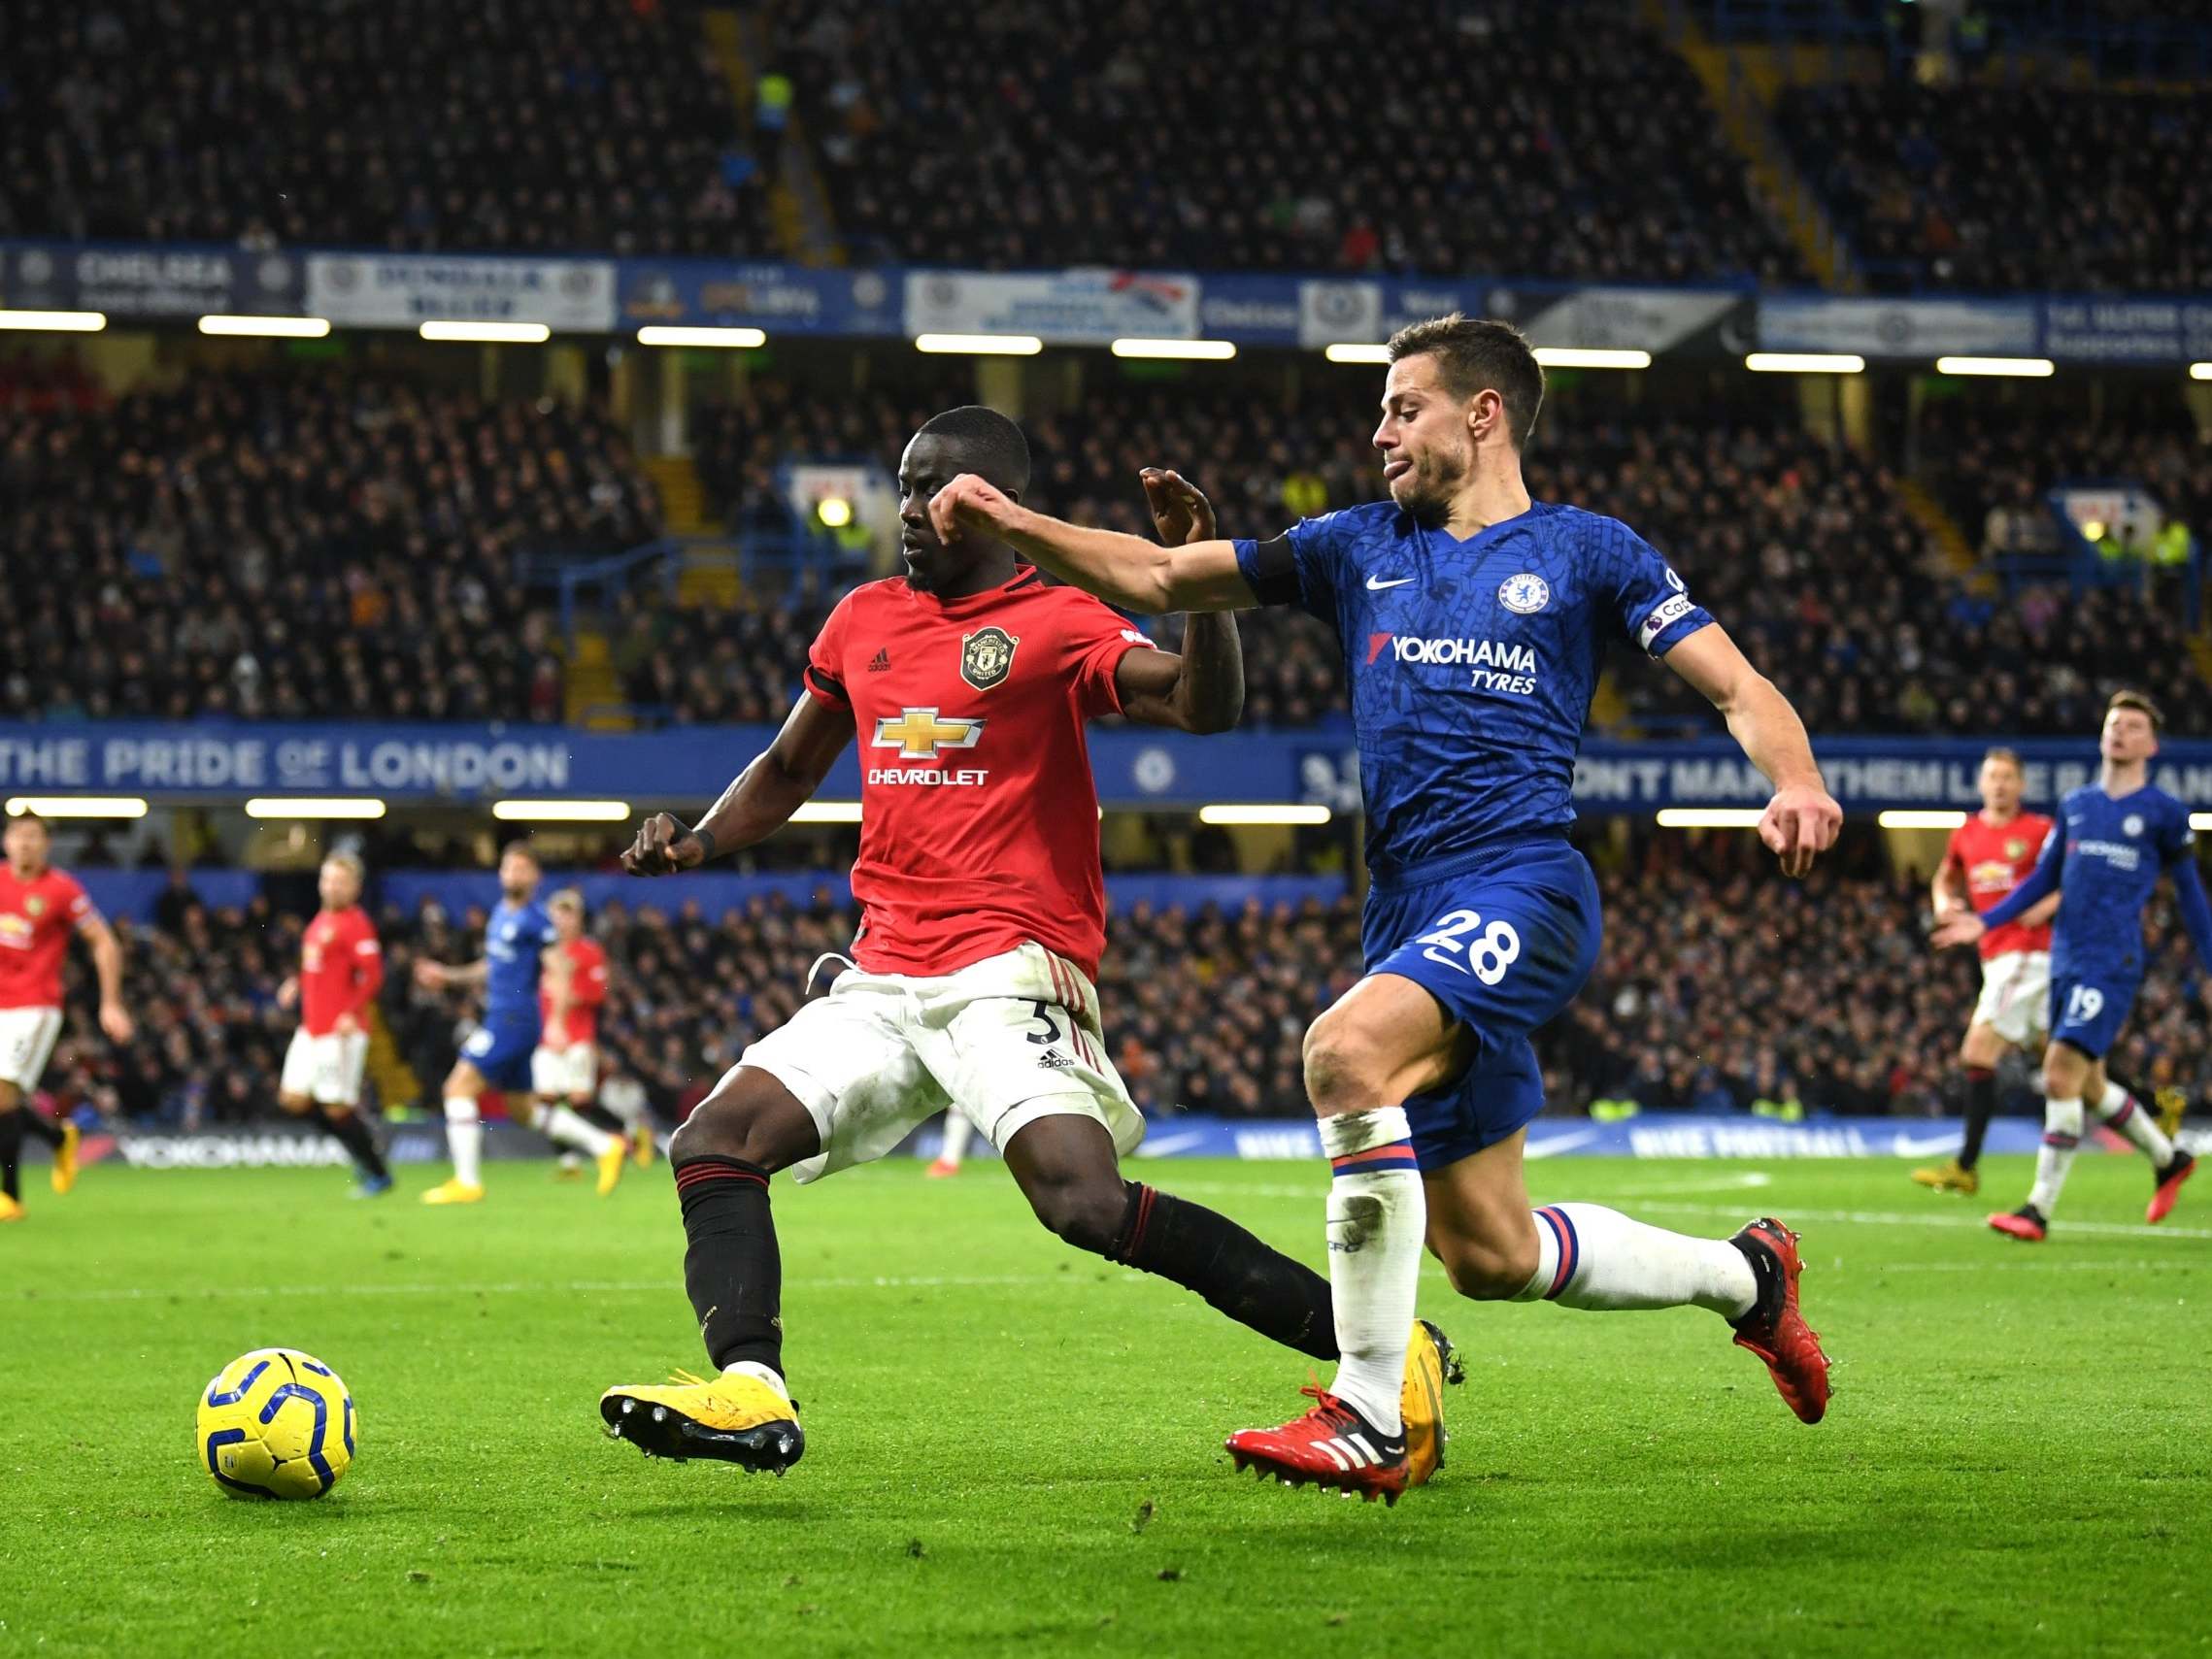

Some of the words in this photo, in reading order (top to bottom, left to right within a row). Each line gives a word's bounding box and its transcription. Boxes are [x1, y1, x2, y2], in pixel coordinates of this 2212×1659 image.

[1392, 636, 1537, 674] YOKOHAMA
[1471, 670, 1537, 695] TYRES
[103, 741, 265, 787] PRIDE
[342, 742, 570, 788] LONDON
[868, 768, 989, 786] CHEVROLET
[1818, 761, 1946, 802] THEM
[1947, 762, 2050, 803] LE
[1416, 909, 1521, 985] 28
[2067, 984, 2104, 1022] 19
[1038, 1057, 1074, 1069] adidas
[121, 1134, 353, 1169] YOKOHAMA
